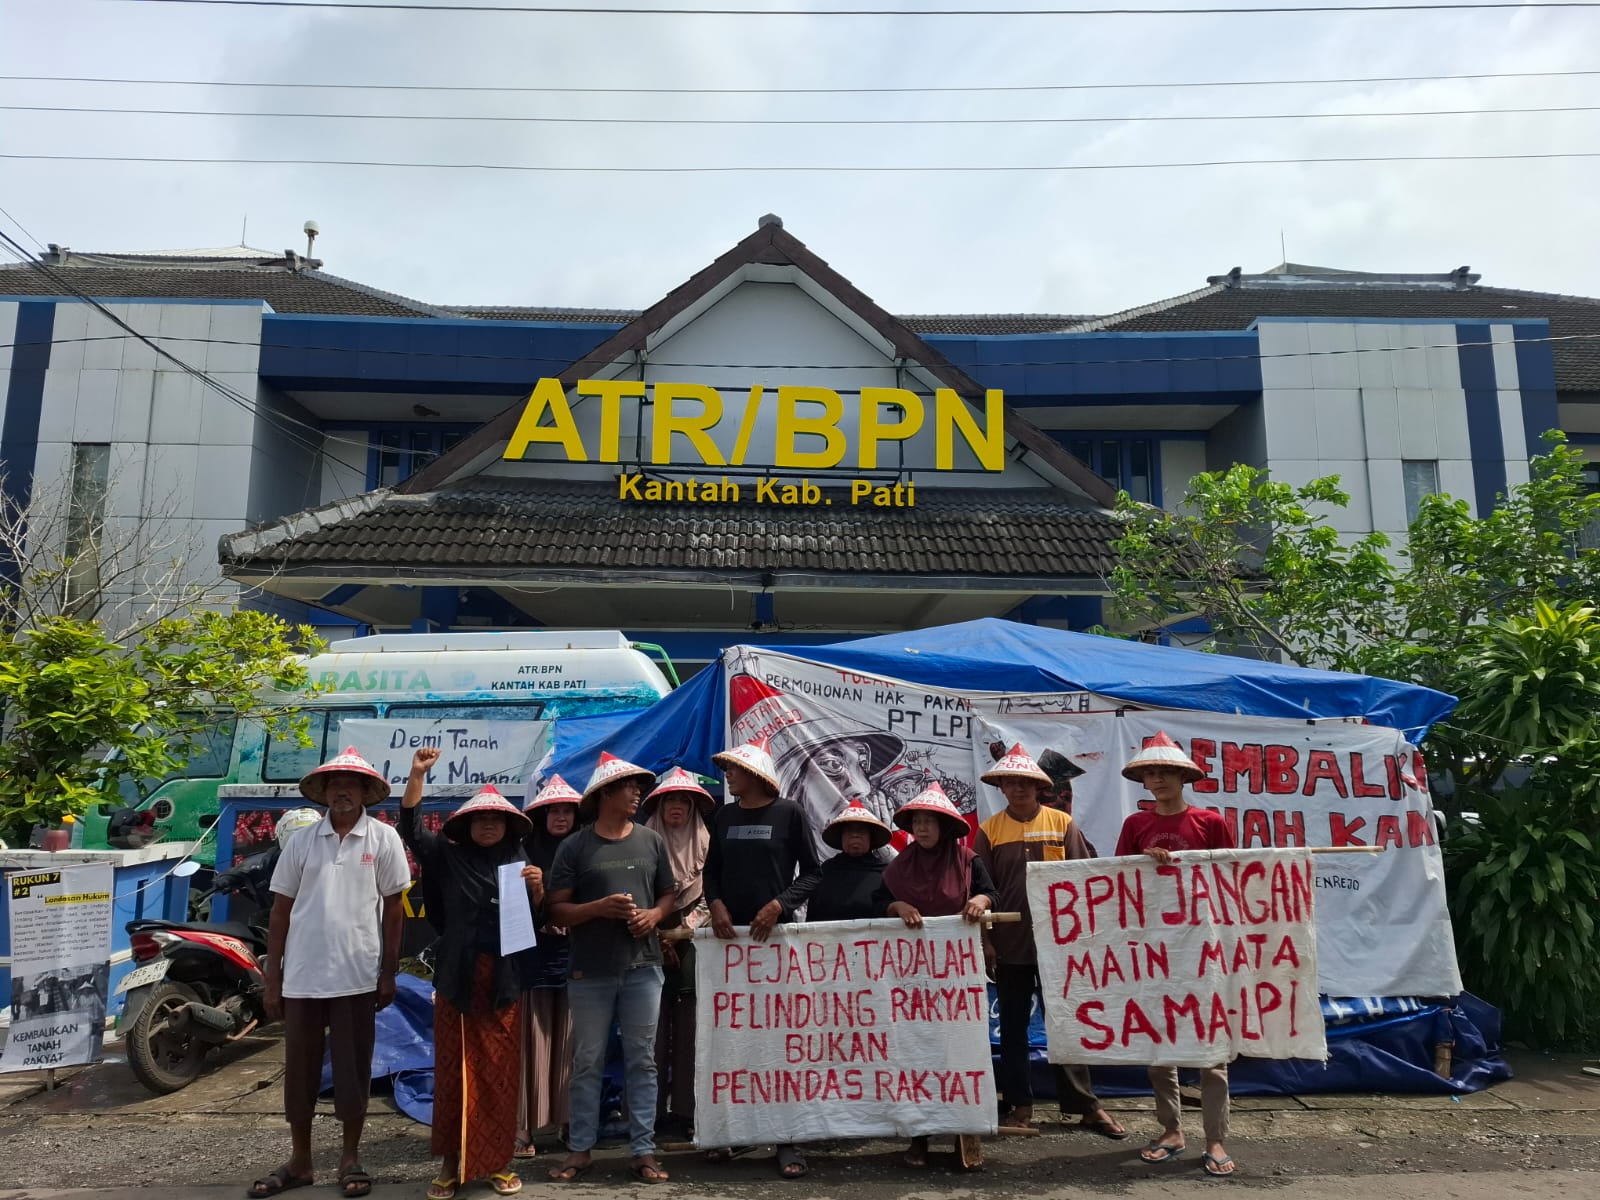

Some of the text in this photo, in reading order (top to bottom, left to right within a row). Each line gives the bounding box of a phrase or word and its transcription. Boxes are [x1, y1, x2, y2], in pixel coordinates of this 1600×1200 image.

[503, 377, 1006, 472] ATR/BPN
[619, 474, 917, 507] Kantah Kab. Pati
[491, 679, 587, 690] KANTAH KAB PATI
[765, 673, 863, 702] PERMOHONAN
[875, 690, 905, 706] HAK
[736, 699, 782, 734] PETANI
[888, 709, 972, 739] PT LPI
[390, 728, 499, 750] Demi Tanah
[13, 872, 60, 886] RUKUN 7
[13, 887, 29, 897] #2
[83, 892, 110, 901] Hukum
[1048, 858, 1312, 945] BPN JANGAN
[1063, 934, 1299, 1000] MAIN MATA
[713, 989, 876, 1029] PELINDUNG
[891, 986, 985, 1023] RAKYAT
[13, 1023, 79, 1042] KEMBALIKAN
[27, 1039, 61, 1053] TANAH
[785, 1031, 889, 1063] BUKAN
[23, 1052, 64, 1066] RAKYAT
[712, 1069, 986, 1105] PENINDAS RAKYAT
